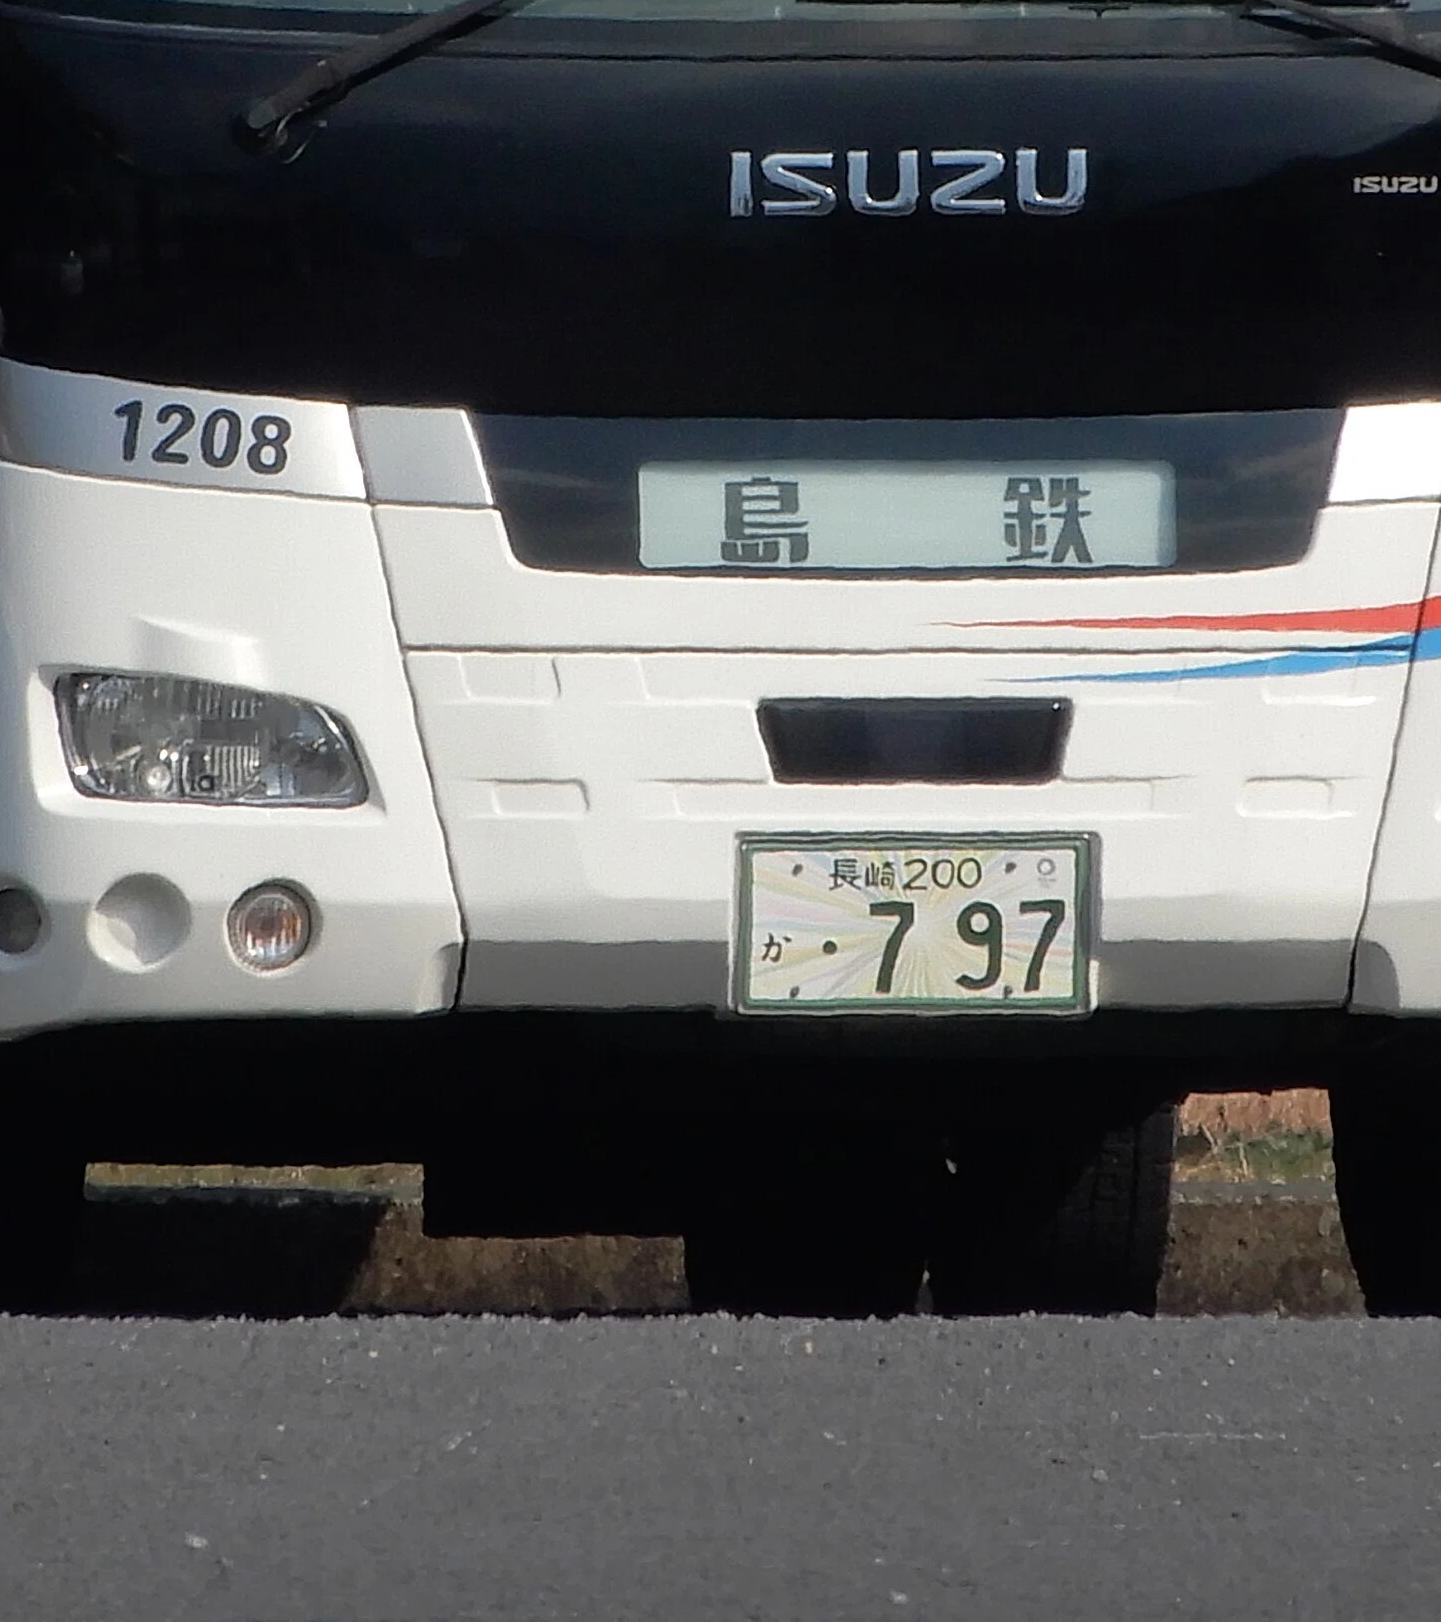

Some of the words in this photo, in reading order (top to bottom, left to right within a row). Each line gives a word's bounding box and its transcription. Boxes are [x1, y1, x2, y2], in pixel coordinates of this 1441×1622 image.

[730, 149, 1088, 217] ISUZU
[1353, 176, 1438, 194] ISUZU
[114, 399, 292, 475] 1208
